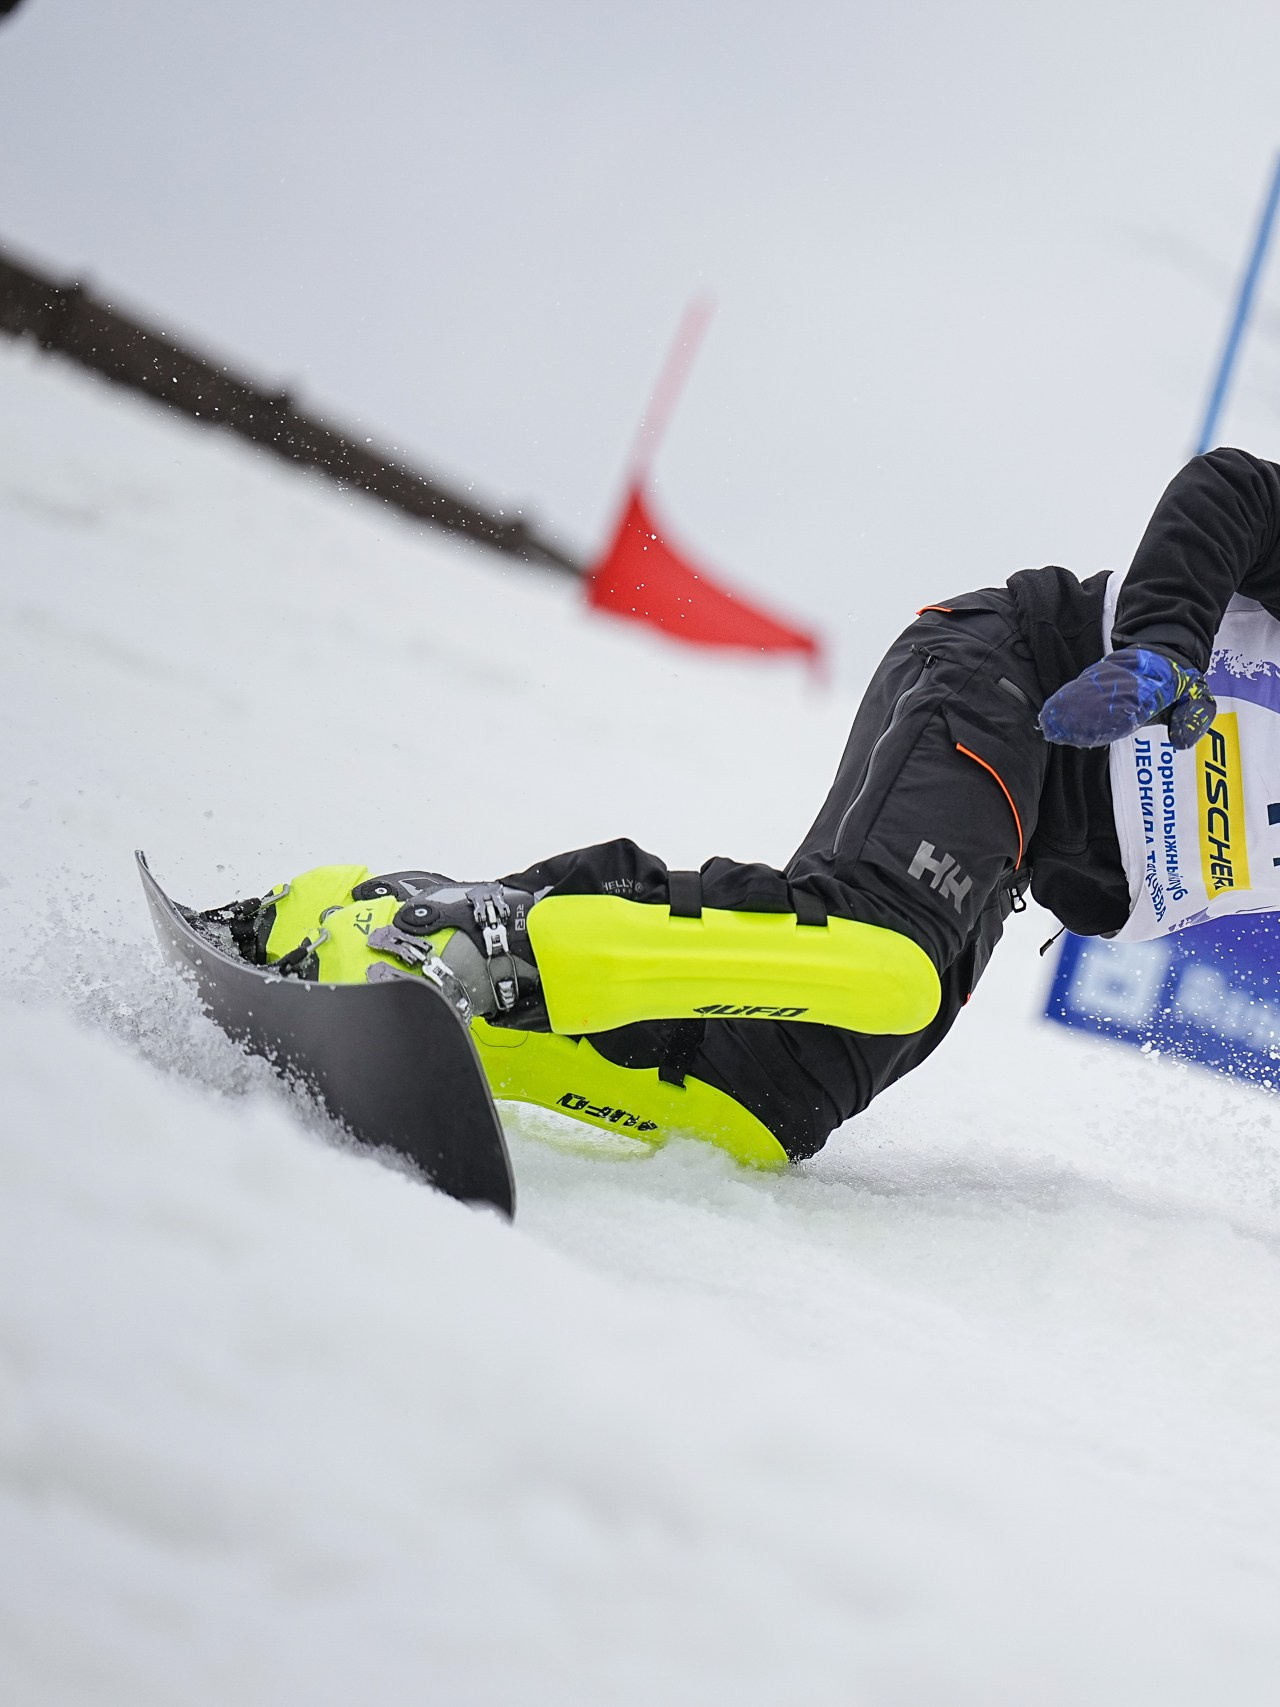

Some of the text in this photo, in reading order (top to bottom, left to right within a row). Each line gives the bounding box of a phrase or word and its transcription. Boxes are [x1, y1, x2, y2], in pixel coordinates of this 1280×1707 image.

[1204, 727, 1235, 890] FISCHER
[907, 840, 973, 914] HH
[1166, 873, 1189, 901] луб
